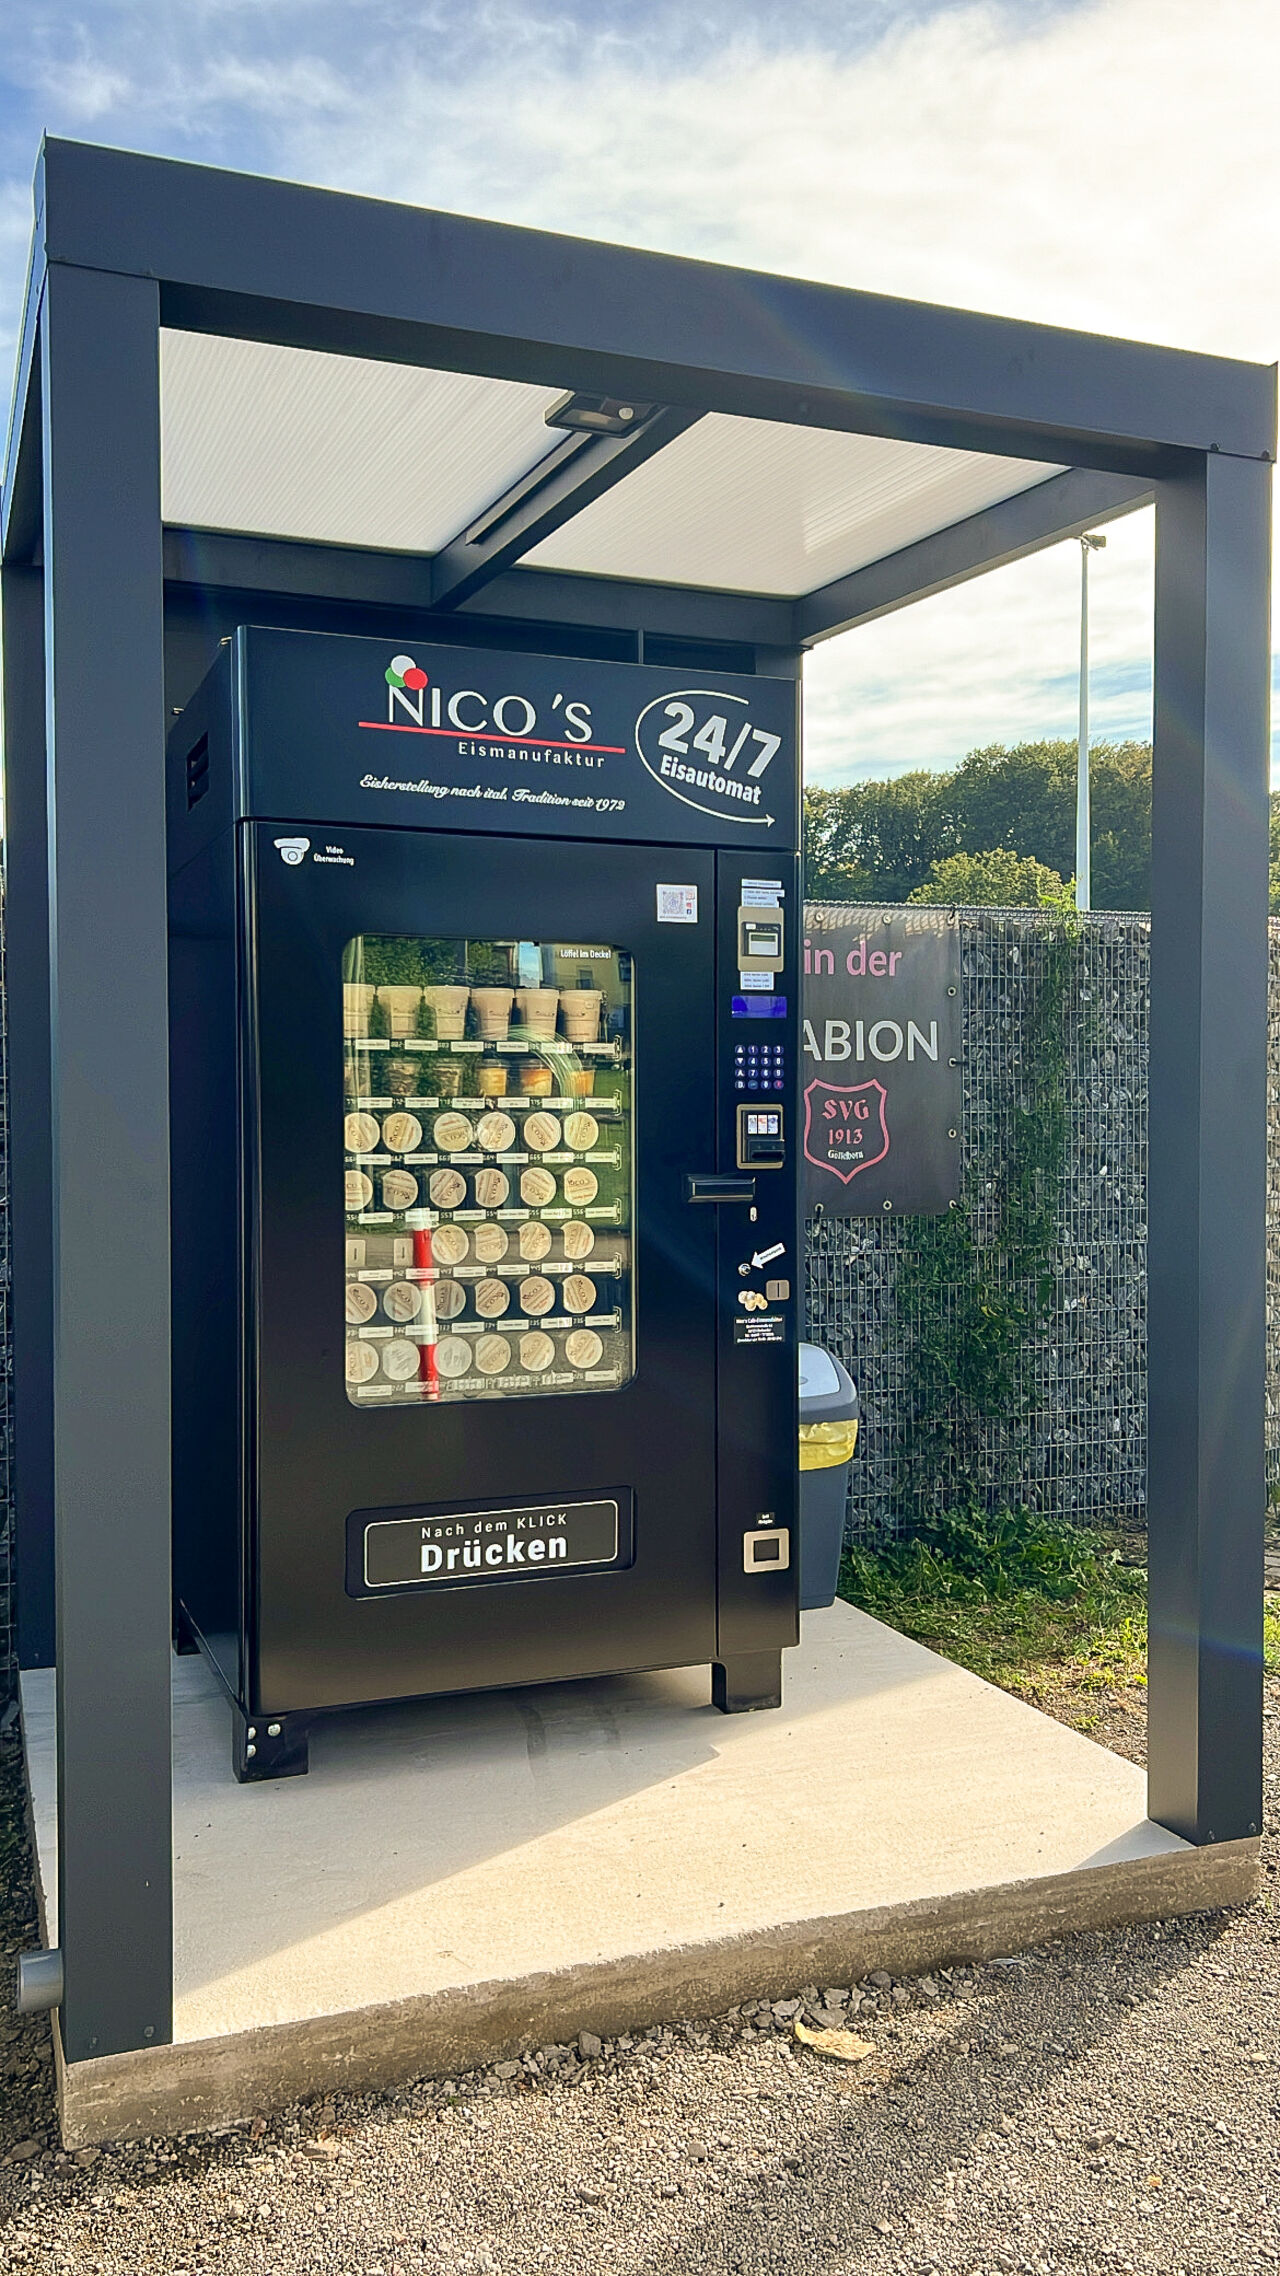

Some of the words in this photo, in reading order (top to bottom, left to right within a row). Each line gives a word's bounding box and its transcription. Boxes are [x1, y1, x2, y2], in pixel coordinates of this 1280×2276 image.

[458, 741, 605, 768] Eismanufaktur
[658, 701, 782, 778] 24/7
[359, 774, 450, 798] Eisherstellung
[450, 785, 483, 799] nach
[511, 789, 571, 806] Tradition
[571, 797, 595, 808] seit
[595, 798, 626, 812] 1972
[660, 754, 762, 805] Eisautomat
[325, 845, 344, 854] Video
[846, 940, 903, 977] der
[822, 1099, 870, 1121] SVG
[828, 1128, 863, 1145] 1913
[421, 1523, 465, 1539] Nach
[474, 1520, 508, 1534] dem
[516, 1513, 567, 1530] KLICK
[420, 1533, 567, 1573] Drücken
